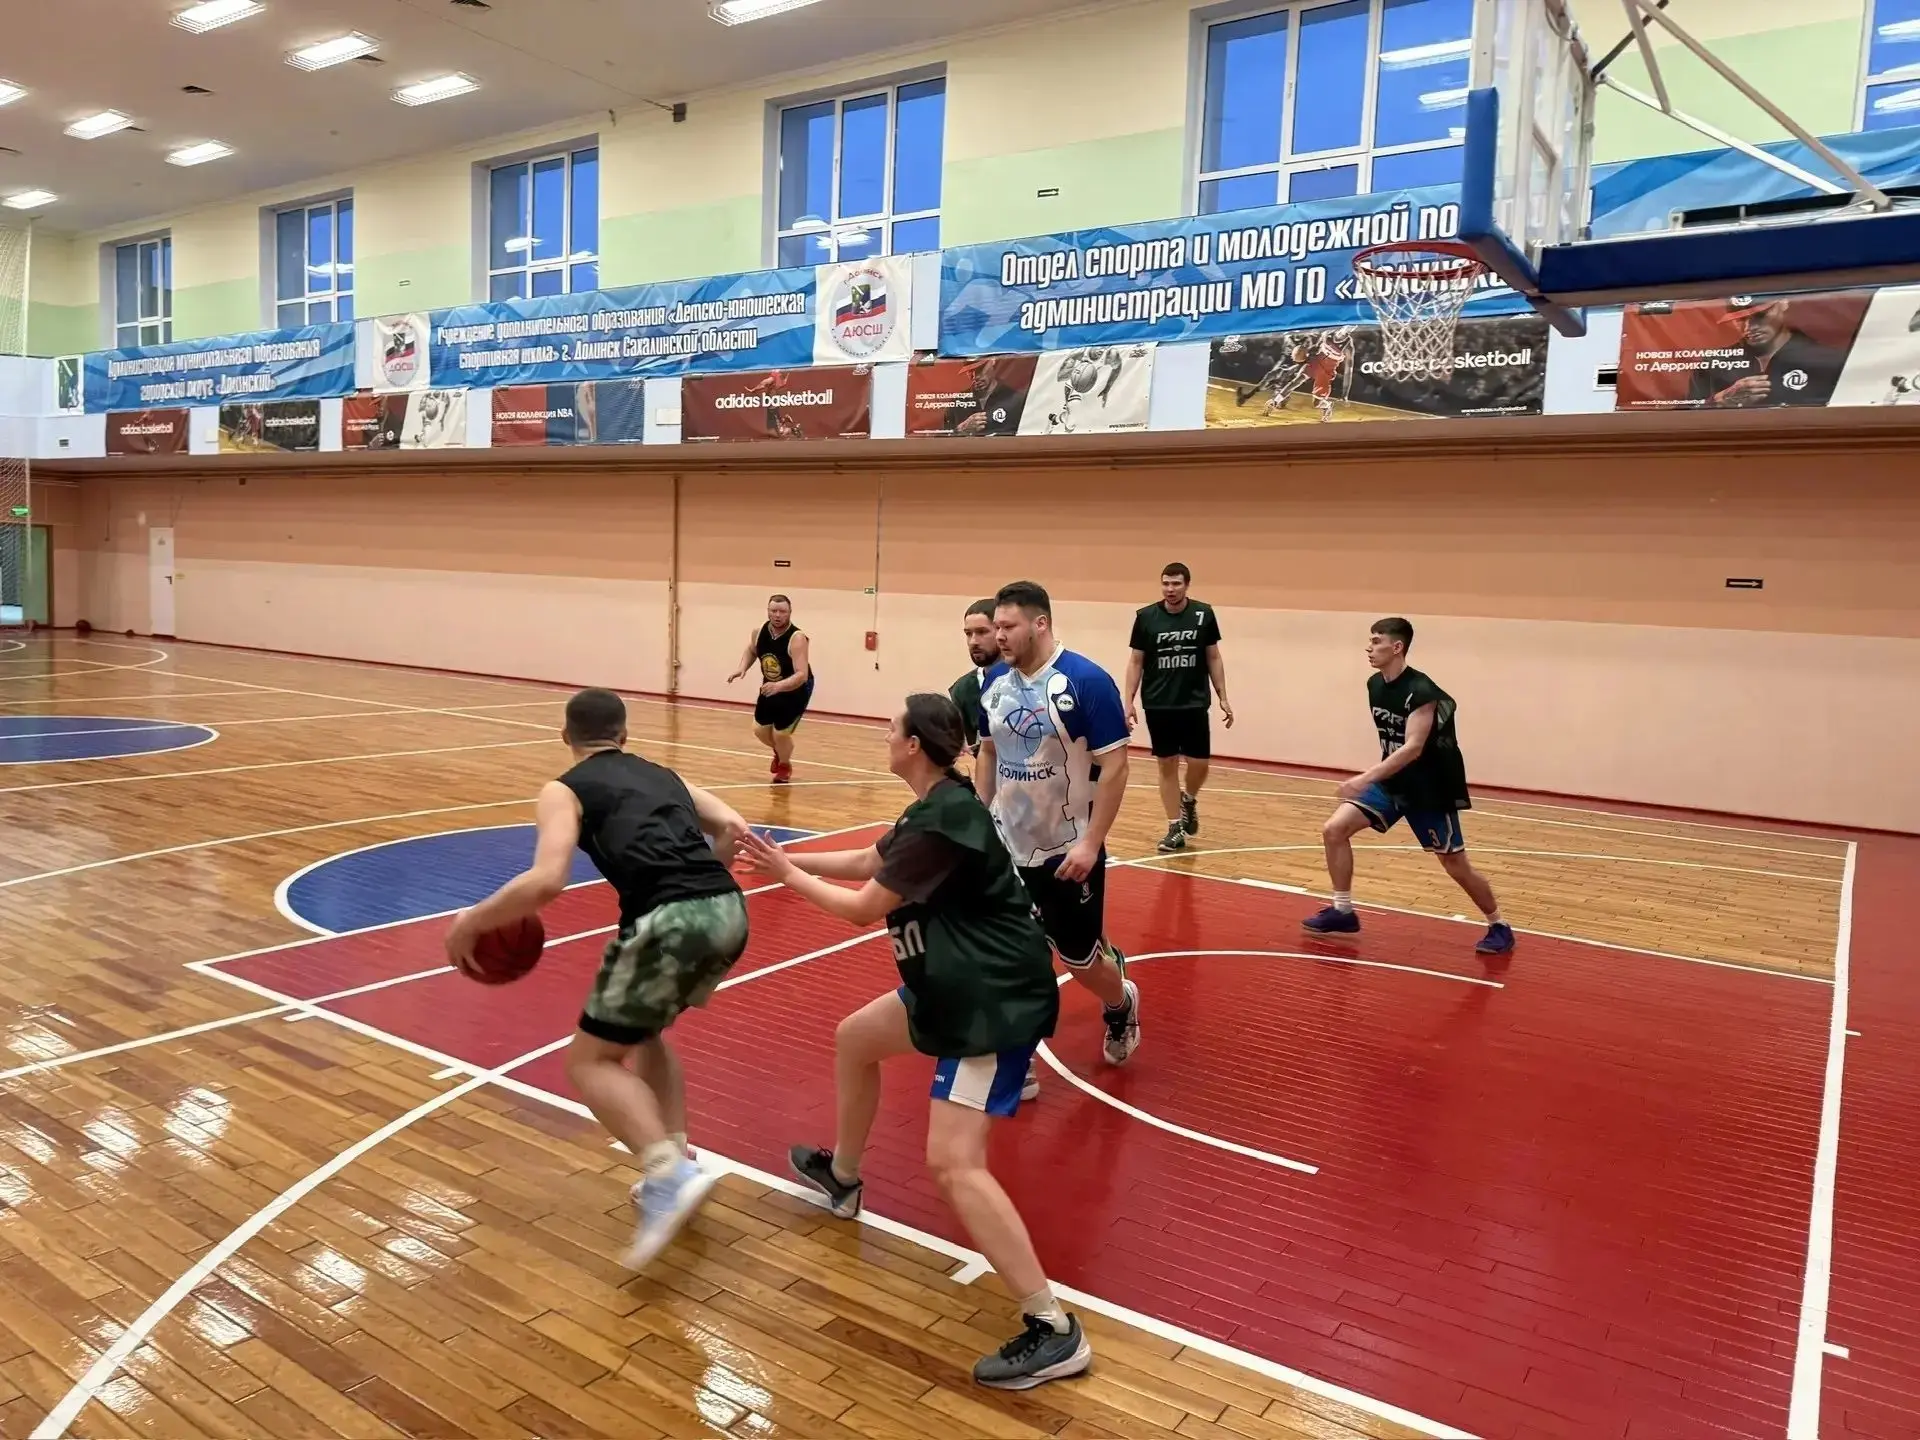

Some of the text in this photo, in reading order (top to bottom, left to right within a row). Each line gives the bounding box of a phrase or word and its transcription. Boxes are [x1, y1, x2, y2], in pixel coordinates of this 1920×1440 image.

[1001, 203, 1458, 288] Отдел спорта и молодежной по
[1020, 281, 1233, 333] администрации
[1241, 271, 1285, 309] МО
[1294, 266, 1326, 304] ГО
[438, 292, 806, 348] Учреждение дополнительного образования «Детско-юношеская
[842, 324, 884, 338] ДЮСШ
[459, 348, 519, 371] спортивная
[521, 344, 560, 367] школа»
[574, 338, 620, 361] Долинск
[622, 330, 698, 357] Сахалинской
[701, 327, 758, 351] области
[1636, 348, 1745, 360] новая коллекция
[1634, 360, 1750, 373] от Деррика Роуза
[715, 388, 833, 409] adidas basketball
[1195, 611, 1205, 626] 7
[1156, 629, 1198, 644] PARI
